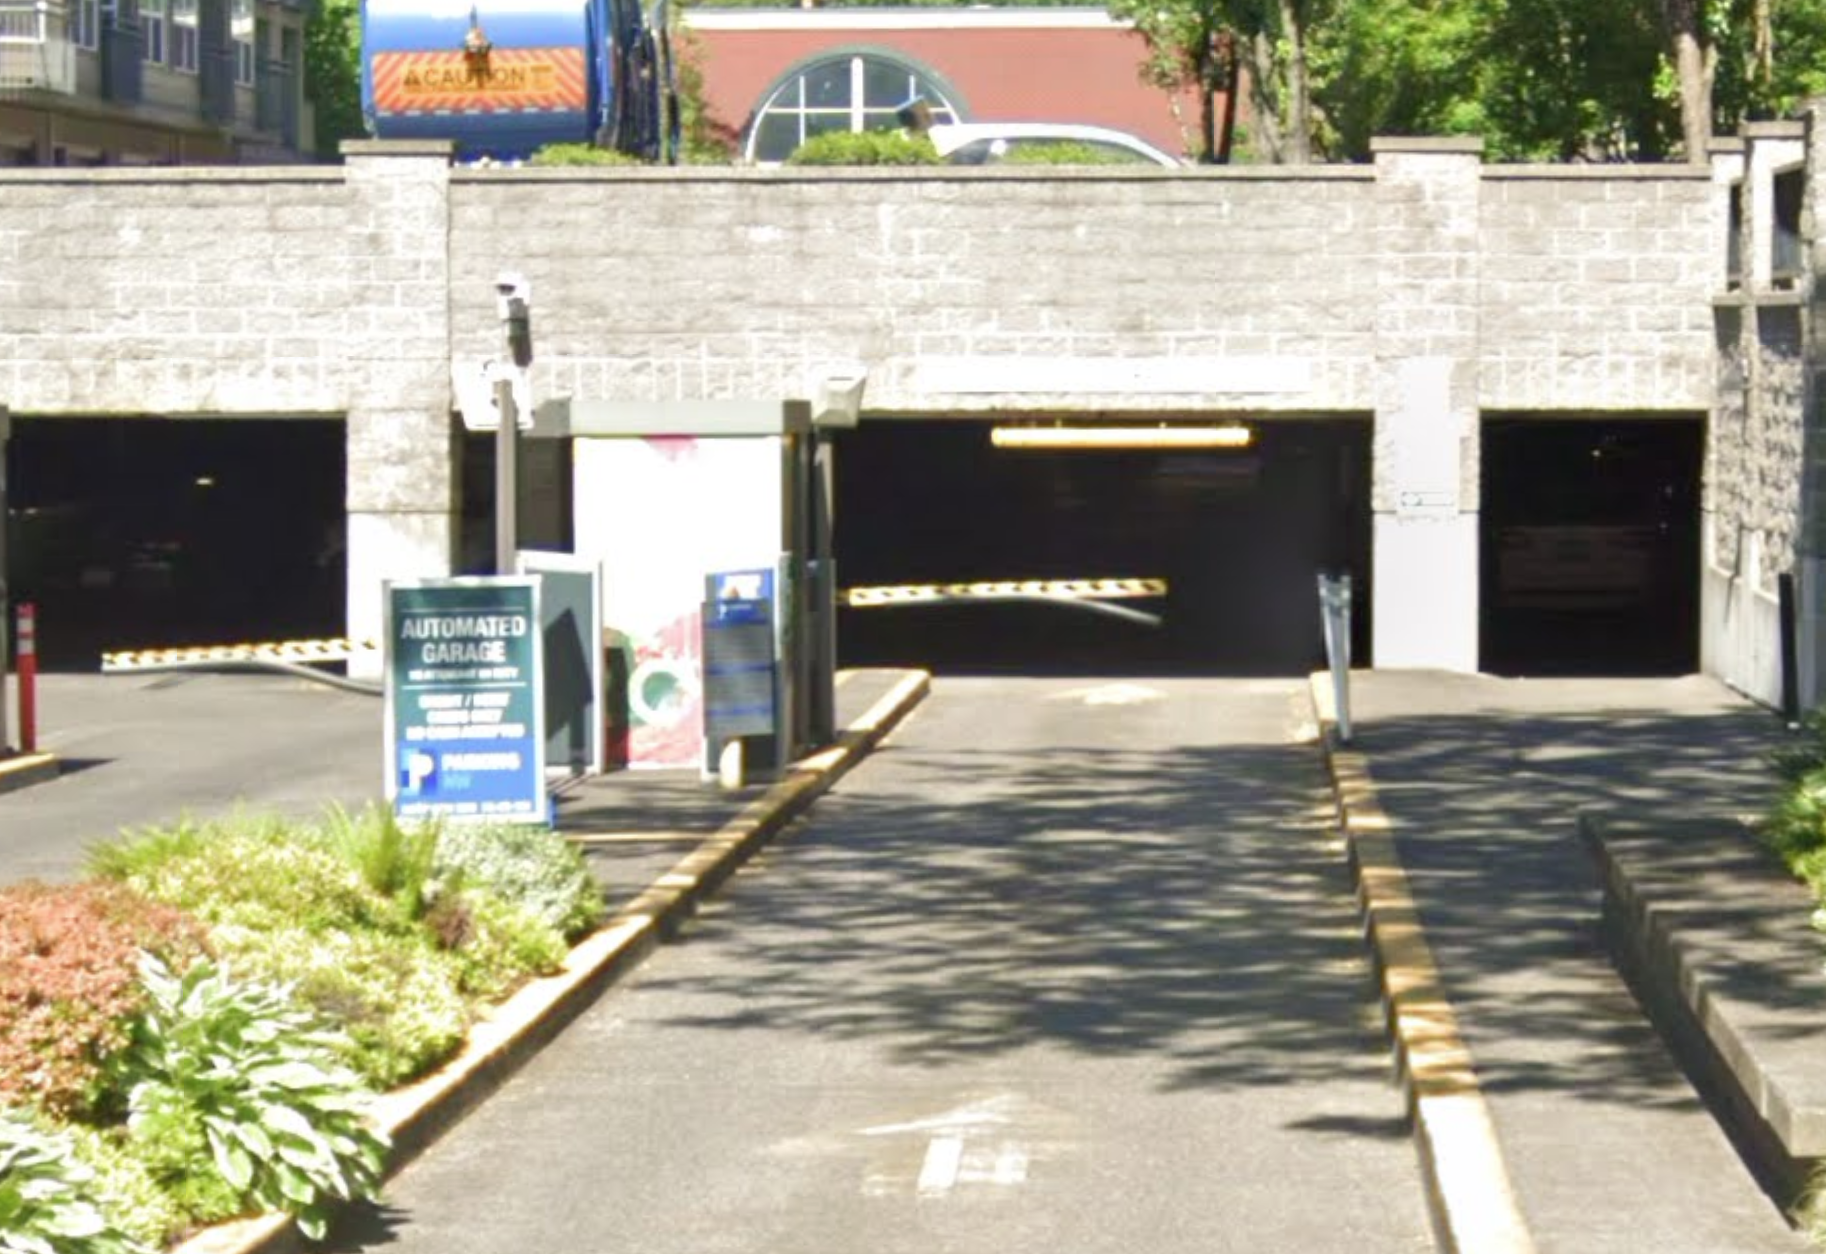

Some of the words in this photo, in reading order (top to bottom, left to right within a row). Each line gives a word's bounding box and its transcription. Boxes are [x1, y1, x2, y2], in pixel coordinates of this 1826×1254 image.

[423, 66, 525, 86] CAUON
[402, 615, 525, 638] AUTOMATED
[422, 641, 506, 664] GARAGE
[409, 752, 434, 793] P
